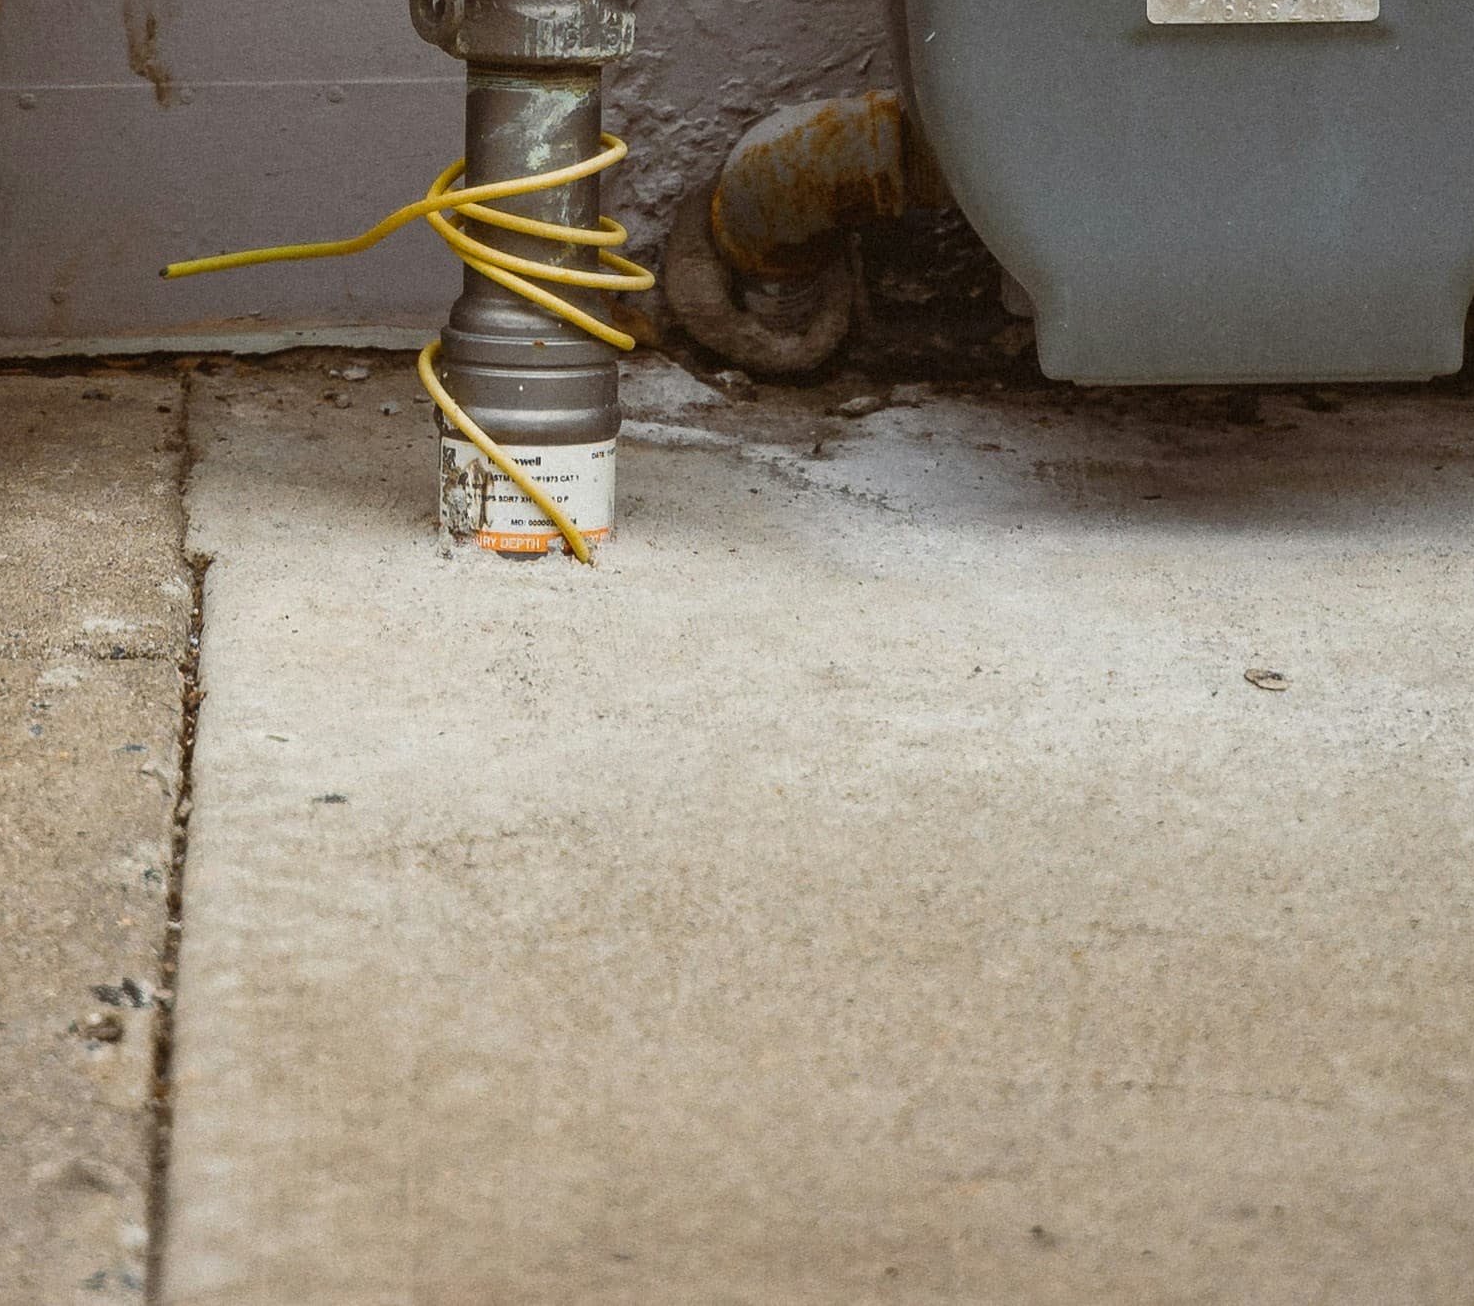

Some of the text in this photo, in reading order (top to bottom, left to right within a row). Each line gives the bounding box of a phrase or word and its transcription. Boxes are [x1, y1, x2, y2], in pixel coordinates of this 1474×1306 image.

[560, 474, 574, 482] CAT
[475, 535, 541, 549] URY DEPTH
